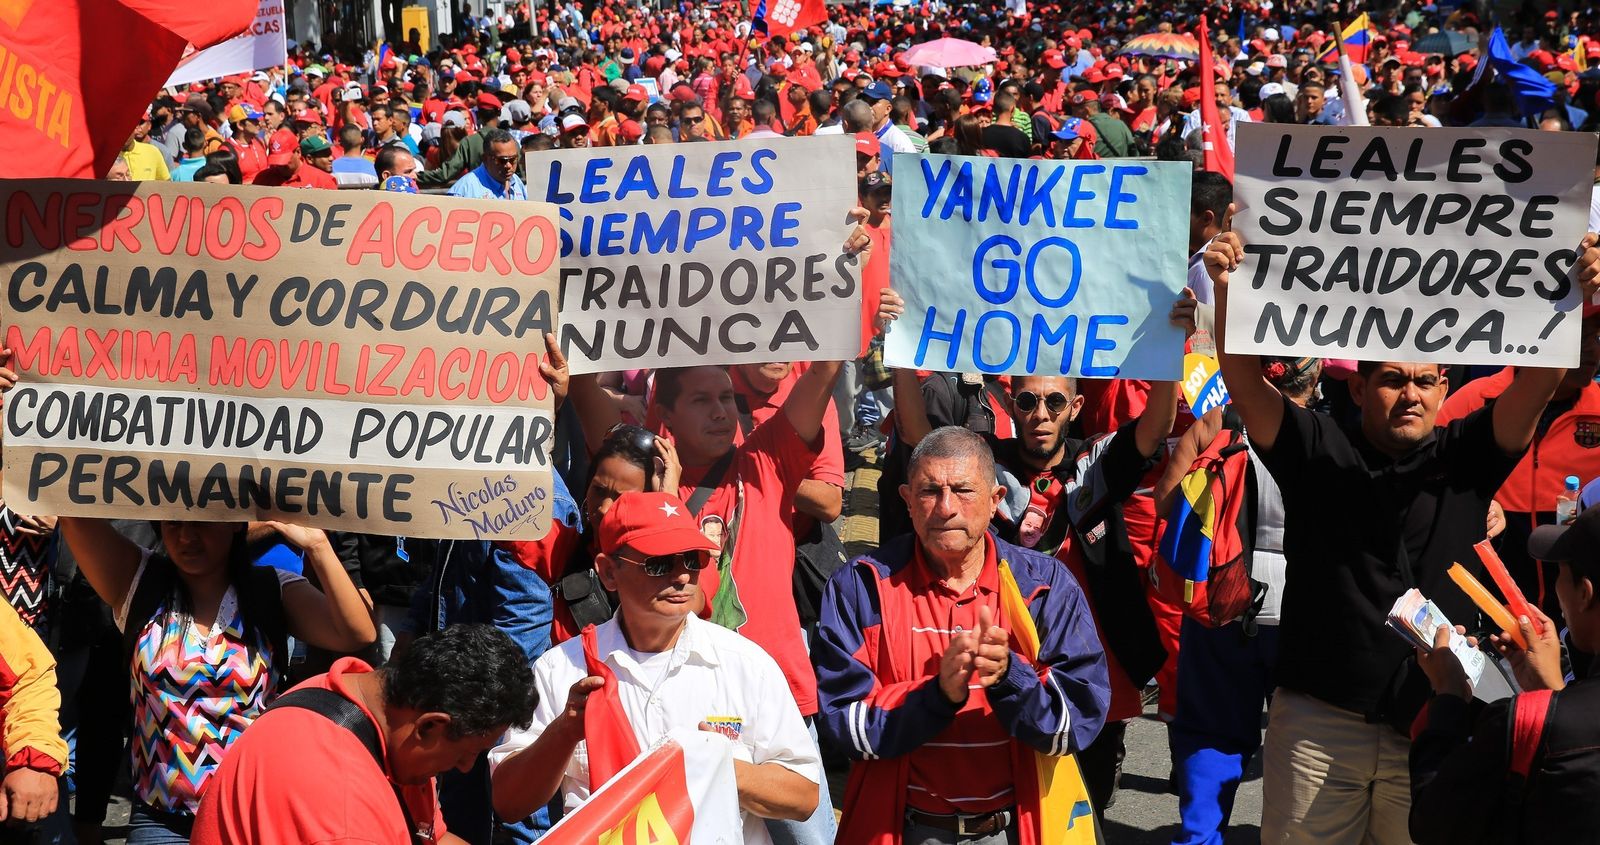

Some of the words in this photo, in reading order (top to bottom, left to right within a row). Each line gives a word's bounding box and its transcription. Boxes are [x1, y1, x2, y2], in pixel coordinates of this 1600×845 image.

[0, 44, 73, 149] ISTA
[546, 148, 778, 204] LEALES
[1272, 133, 1533, 183] LEALES
[920, 158, 1148, 230] YANKEE
[1259, 187, 1560, 239] SIEMPRE
[6, 190, 284, 261] NERVIOS
[290, 202, 352, 247] DE
[346, 201, 557, 276] ACERO
[8, 262, 213, 320] CALMA
[226, 272, 259, 318] Y
[269, 276, 552, 338] CORDURA
[558, 252, 858, 313] TRAIDORES
[972, 234, 1082, 308] GO
[1244, 243, 1578, 301] TRAIDORES
[6, 325, 197, 384] MAXIMA
[208, 335, 549, 403] MOVILIZACION
[561, 310, 819, 361] NUNCA
[914, 305, 1129, 377] HOME
[1185, 361, 1209, 397] SOY
[7, 388, 324, 455] COMBATIVIDAD
[349, 407, 552, 466] POPULAR
[27, 452, 415, 523] PERMANENTE
[431, 474, 518, 526] Nicolas
[462, 487, 546, 539] Maduro
